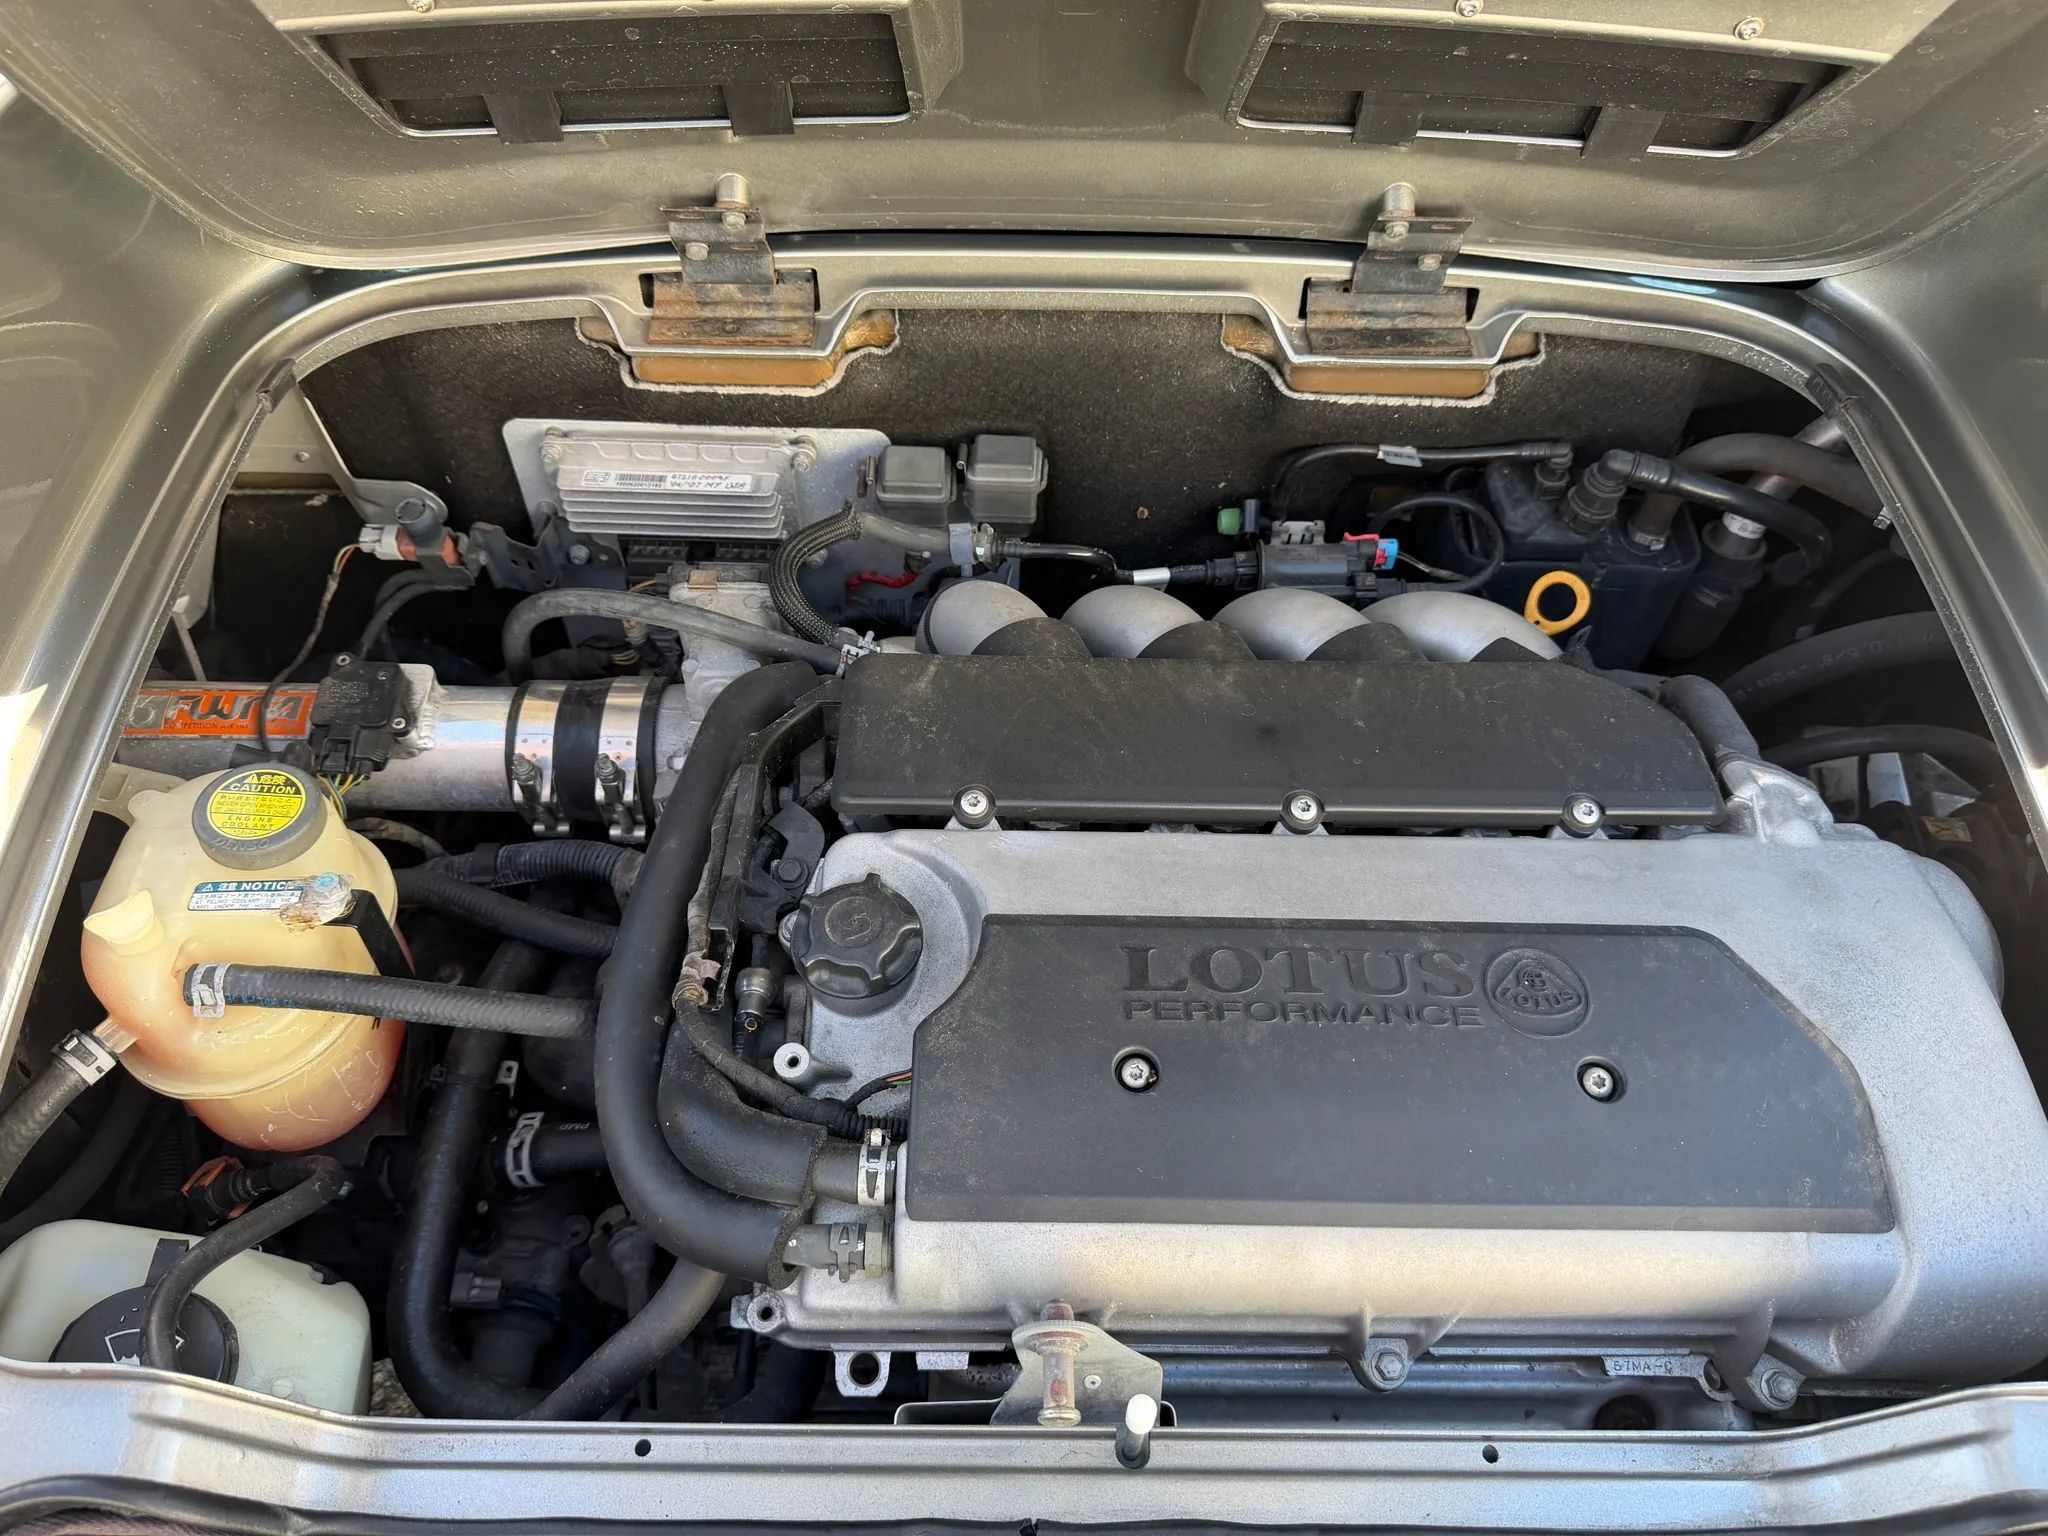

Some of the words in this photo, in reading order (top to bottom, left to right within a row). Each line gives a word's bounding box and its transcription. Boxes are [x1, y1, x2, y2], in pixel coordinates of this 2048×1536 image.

[168, 695, 305, 721] FUJIA
[259, 773, 287, 785] 危険
[230, 783, 296, 794] CAUTION
[221, 821, 275, 830] COOLANT
[227, 815, 273, 823] ENGINE
[210, 837, 270, 851] DENSO
[217, 882, 238, 891] 注意
[1122, 945, 1475, 999] LOTUS
[1500, 986, 1574, 1010] LOTUS
[1124, 1001, 1484, 1028] PERFORMANCE
